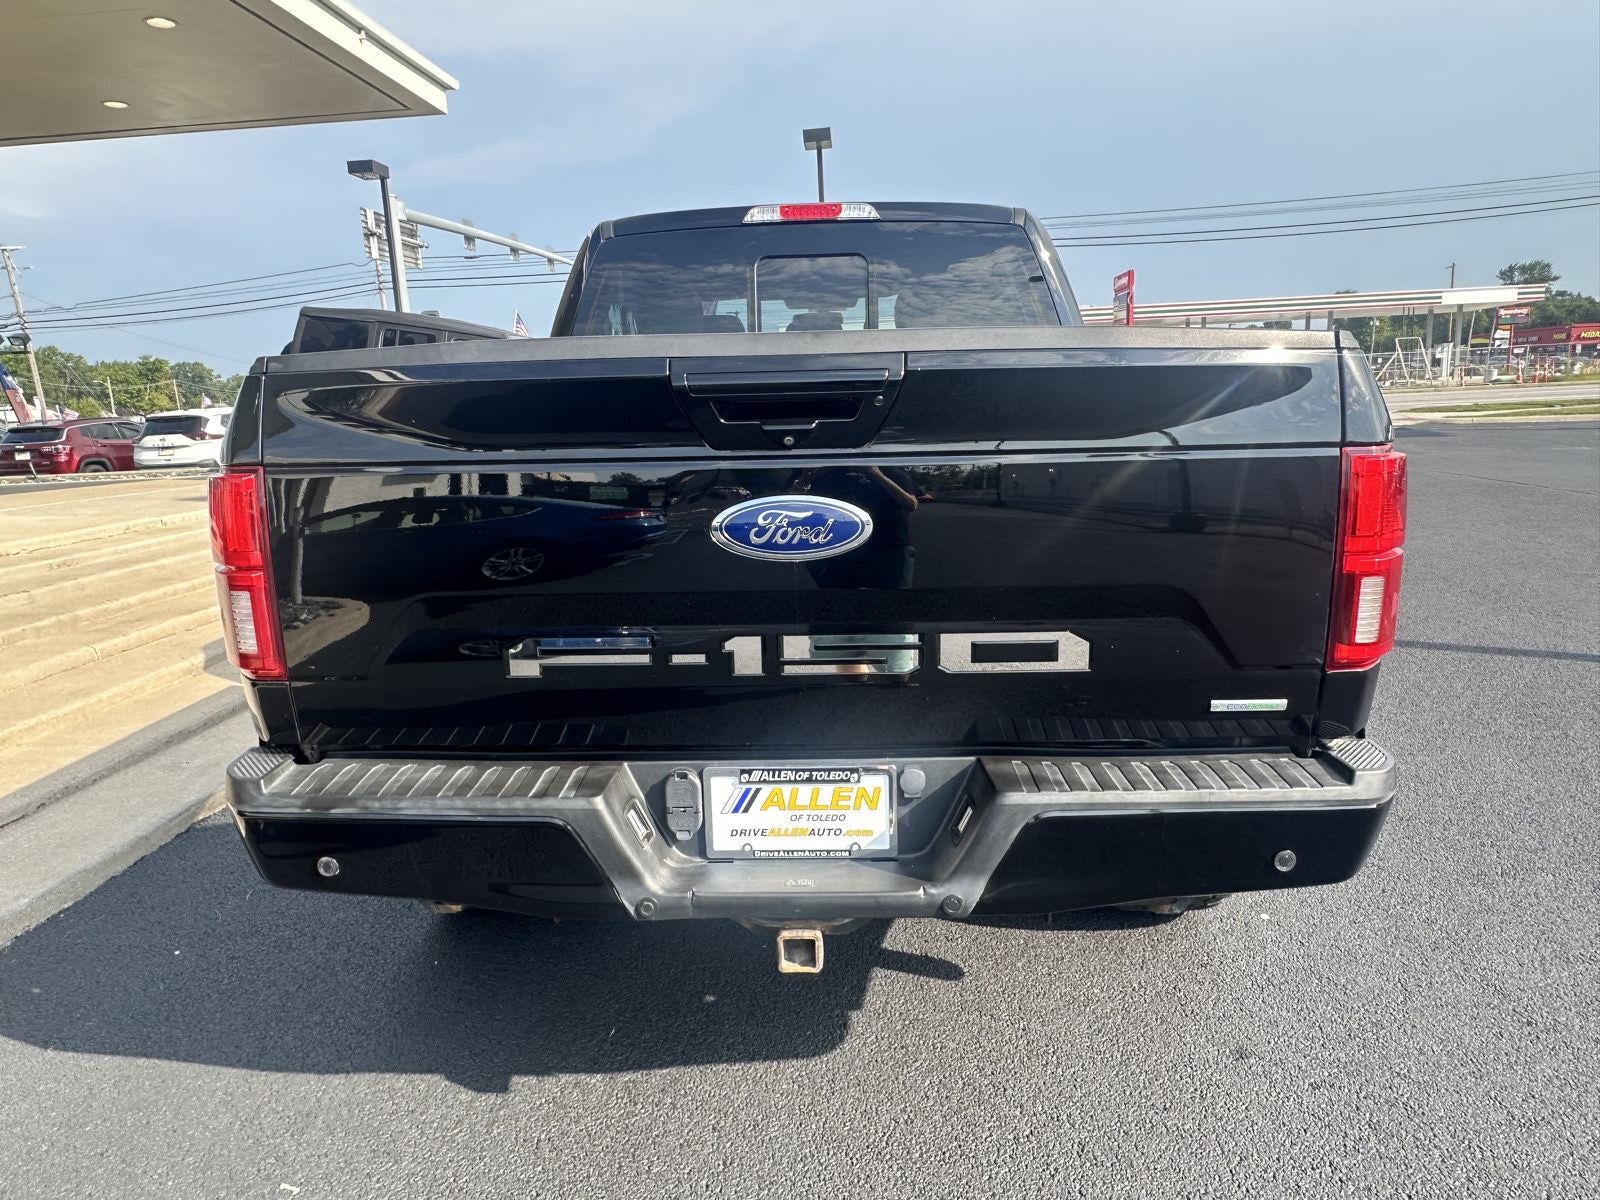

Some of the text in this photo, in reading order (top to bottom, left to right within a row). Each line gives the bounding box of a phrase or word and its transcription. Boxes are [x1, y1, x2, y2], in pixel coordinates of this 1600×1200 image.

[748, 508, 836, 546] Ford
[506, 630, 1092, 678] F-150
[761, 770, 850, 781] ALLEN OF TOLEDO
[760, 786, 882, 811] ALLEN
[790, 813, 846, 822] OF TOLEDO
